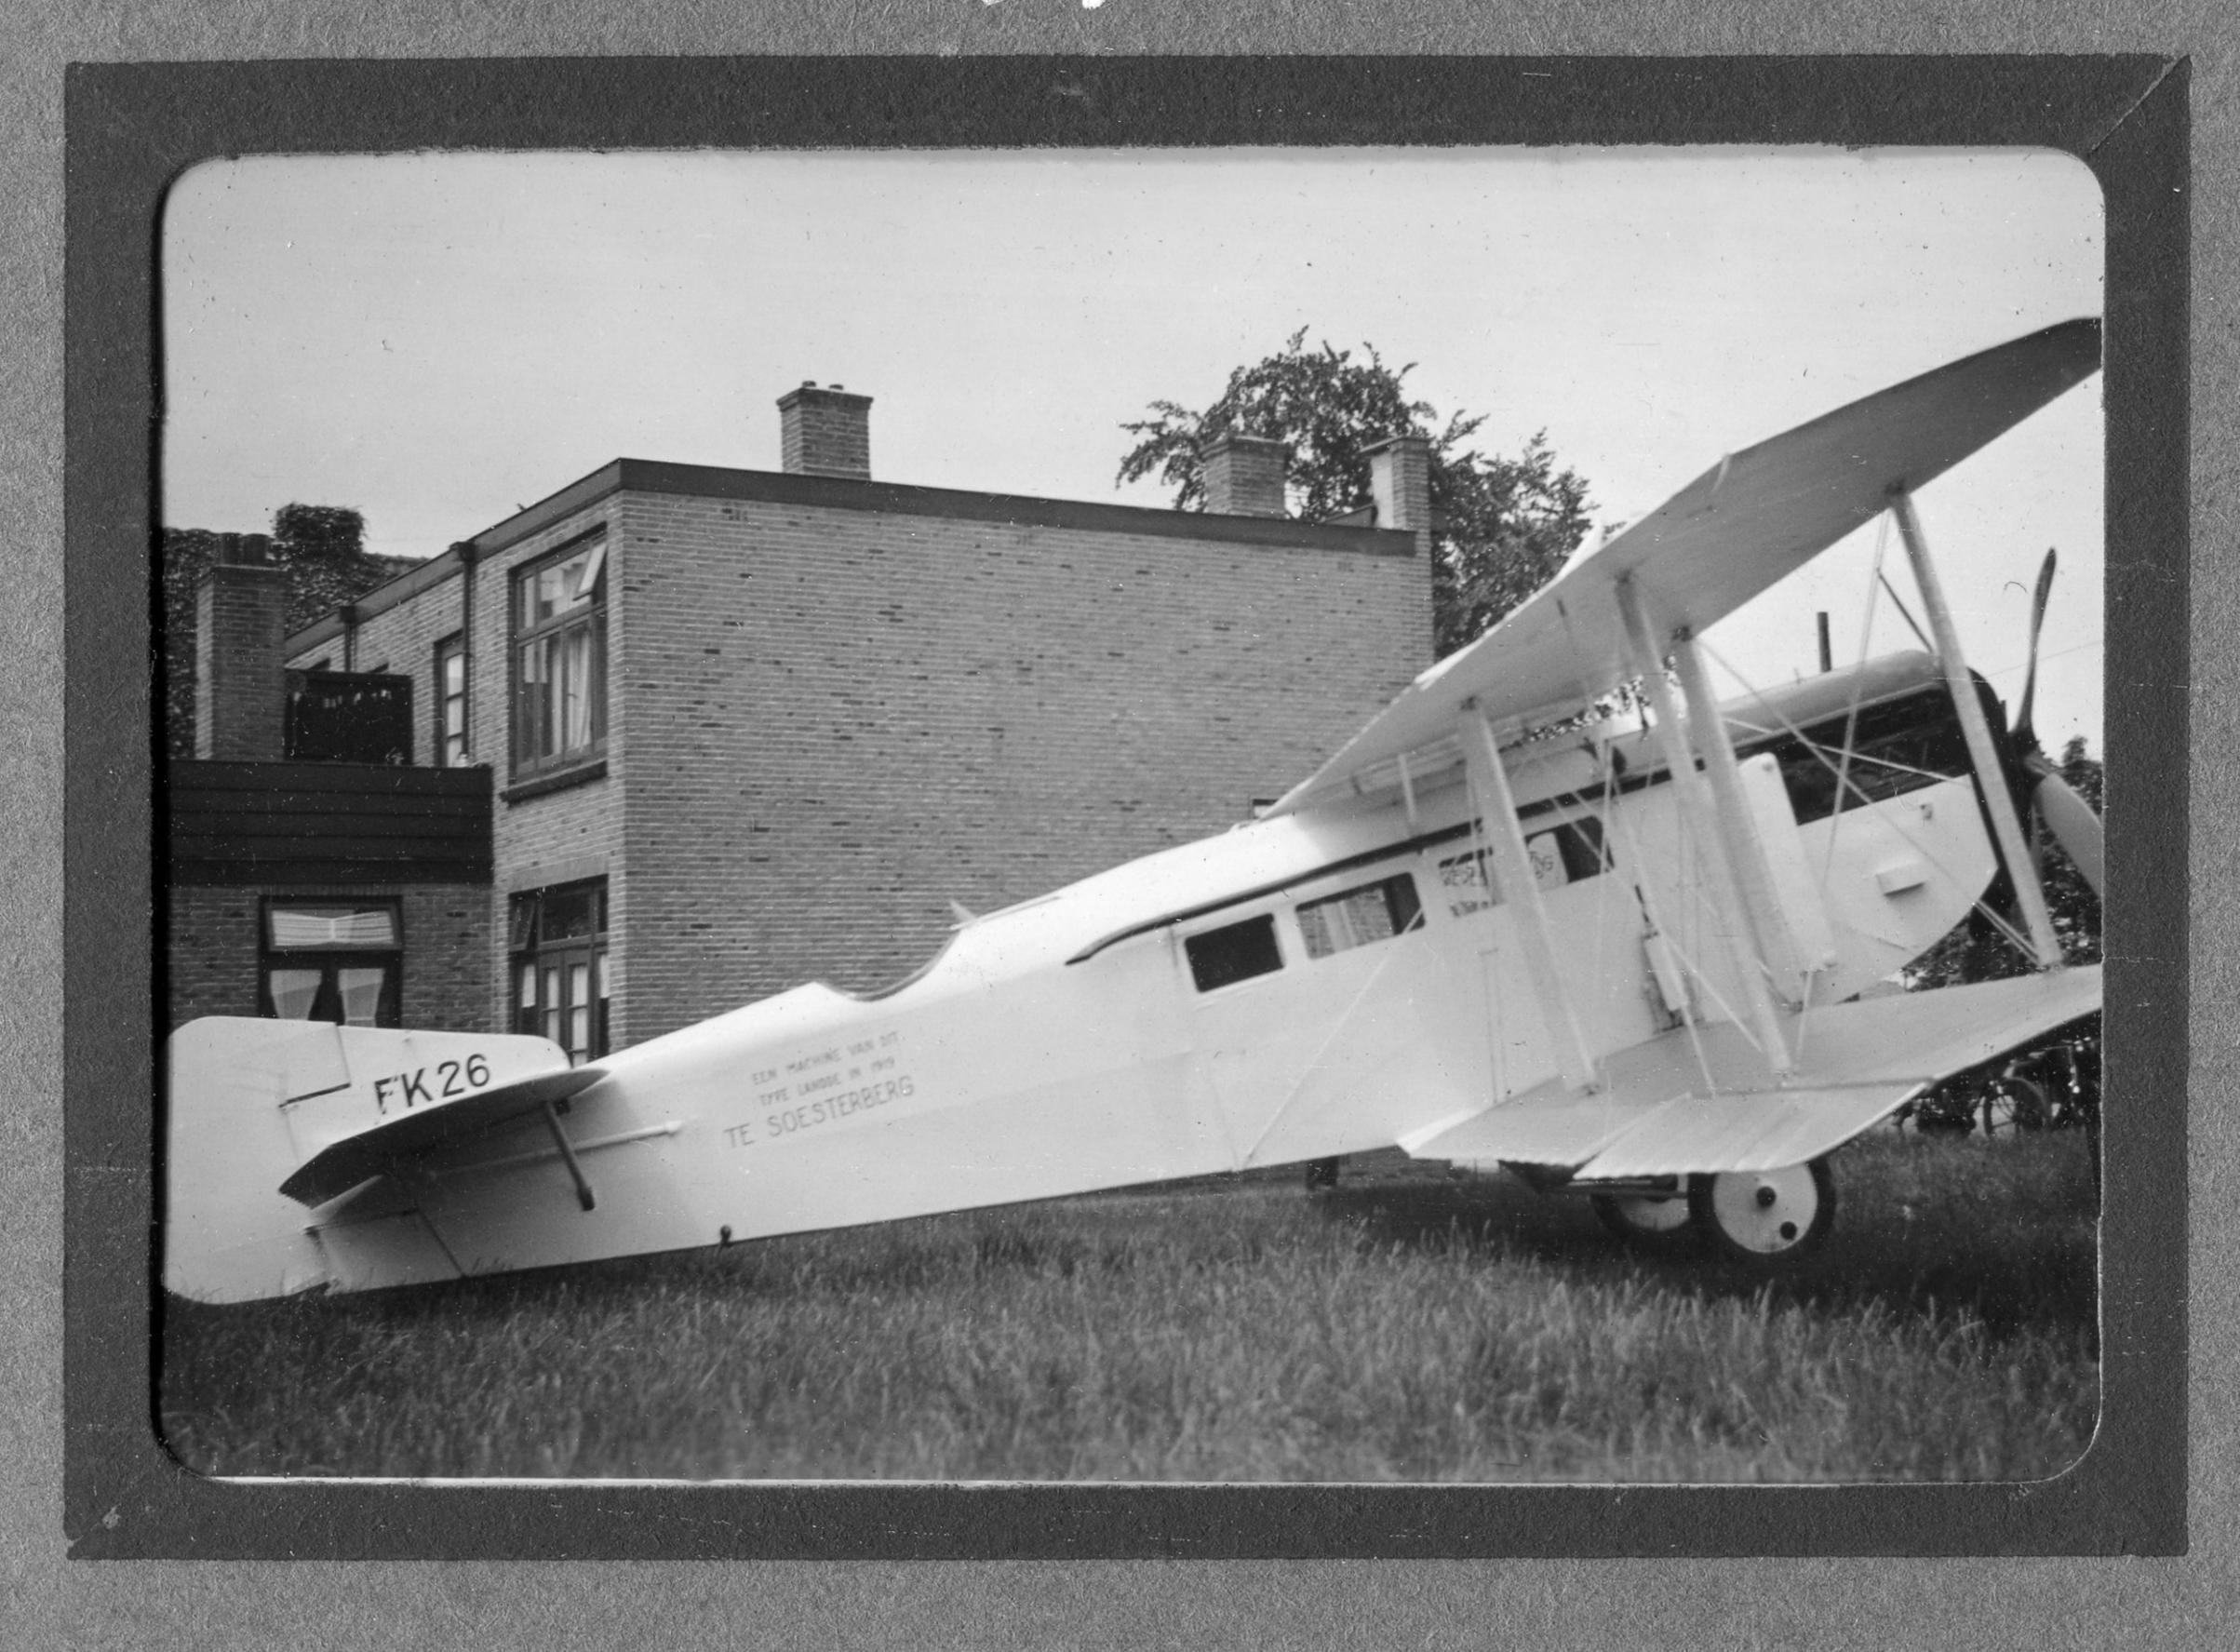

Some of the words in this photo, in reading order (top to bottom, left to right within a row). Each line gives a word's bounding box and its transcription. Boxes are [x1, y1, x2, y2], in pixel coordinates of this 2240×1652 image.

[374, 1053, 490, 1116] FK26
[752, 1069, 778, 1086] EEN
[723, 1122, 757, 1148] TE
[767, 1075, 916, 1138] SOESTERBERG
